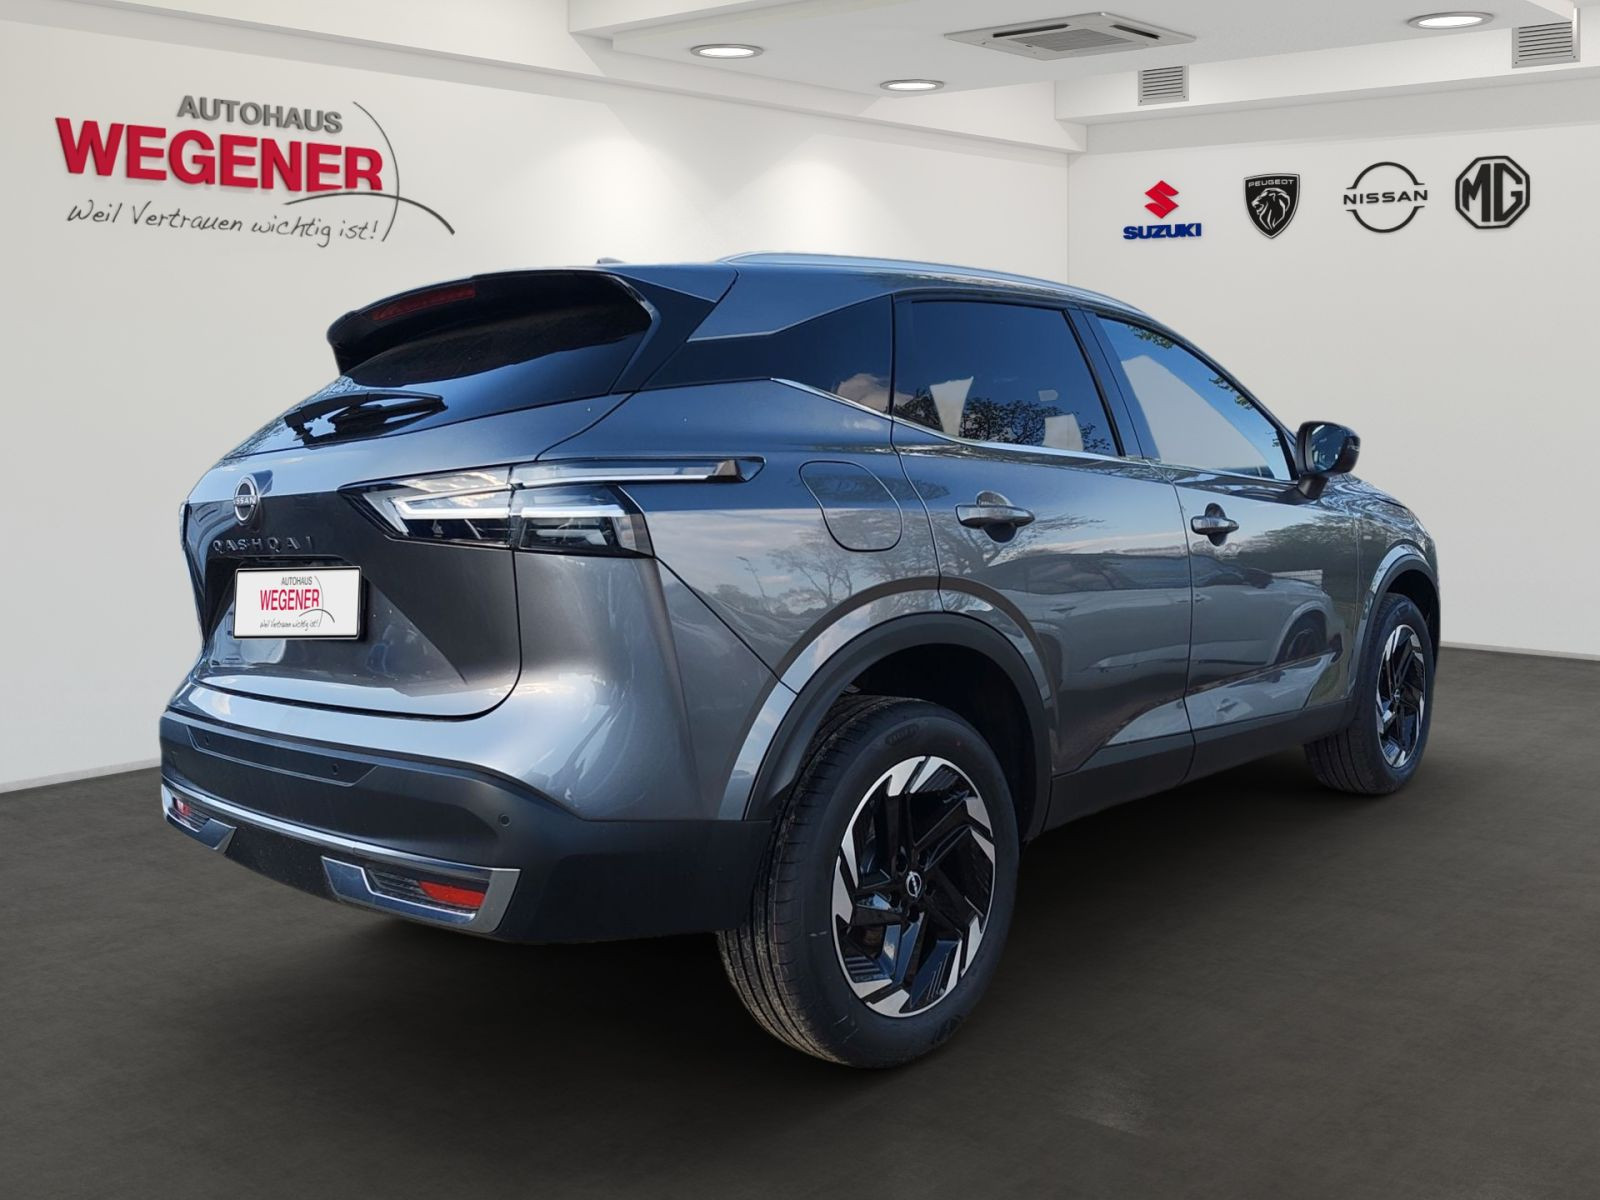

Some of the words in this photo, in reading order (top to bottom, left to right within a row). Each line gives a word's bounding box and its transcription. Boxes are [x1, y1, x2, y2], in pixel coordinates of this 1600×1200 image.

[177, 95, 343, 134] AUTOHAUS
[55, 117, 383, 192] WEGENER
[1248, 179, 1295, 187] PEUGEOT
[1461, 162, 1524, 223] MG
[1343, 189, 1428, 206] NISSAN
[67, 199, 120, 223] Weil
[131, 200, 243, 233] Vertrauen
[251, 217, 332, 247] wichtig
[338, 219, 378, 241] ist!
[1123, 222, 1202, 240] SUZUKI
[212, 535, 313, 554] QASHQAI
[281, 576, 312, 586] AUTOHAUS
[260, 589, 319, 610] WEGENER
